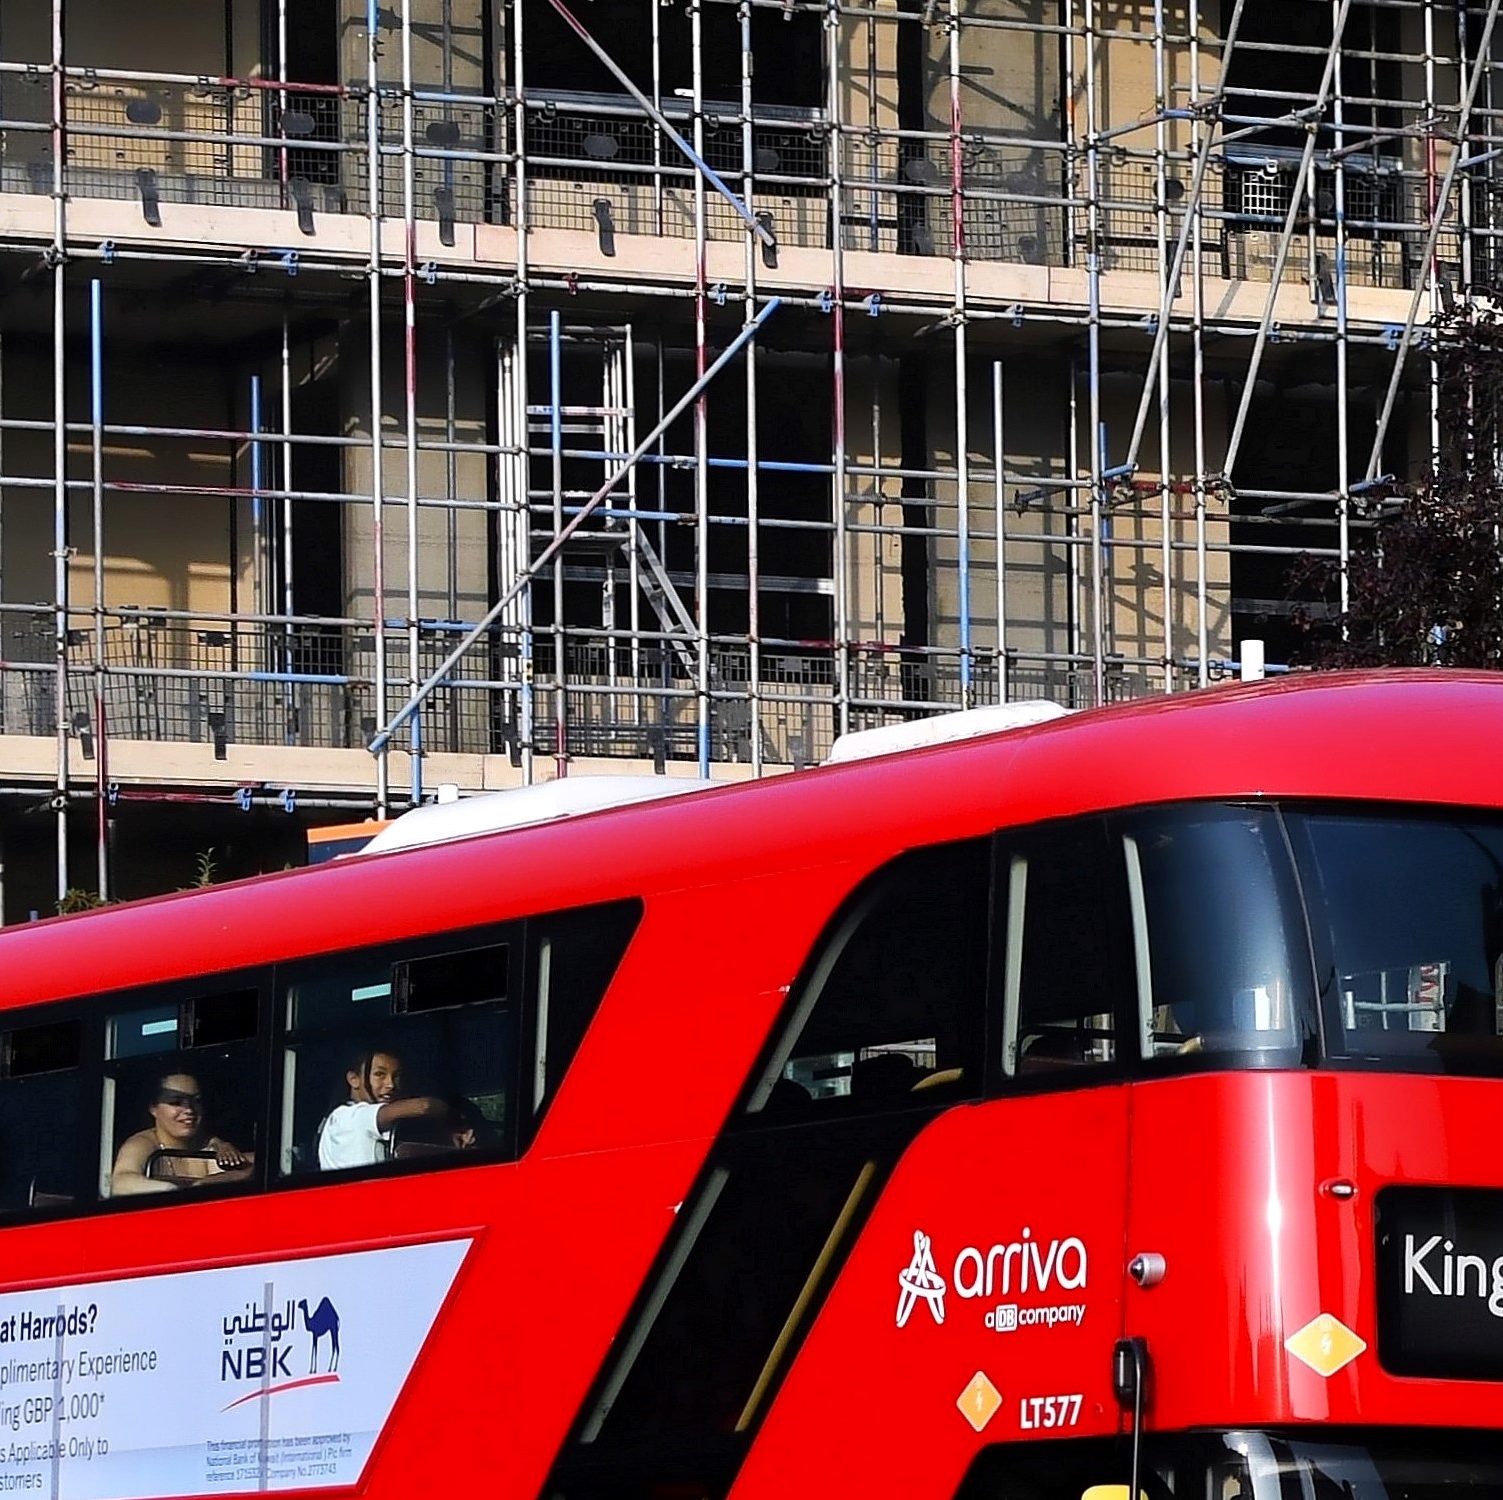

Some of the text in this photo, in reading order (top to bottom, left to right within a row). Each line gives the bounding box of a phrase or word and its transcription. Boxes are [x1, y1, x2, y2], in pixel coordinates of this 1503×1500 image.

[953, 1226, 1087, 1298] arriva
[0, 1315, 16, 1343] at
[20, 1303, 98, 1341] Harrods?
[223, 1299, 296, 1345] الوطني
[985, 1304, 1086, 1328] a DB company
[79, 1347, 157, 1381] Experience
[221, 1345, 293, 1381] NBK
[24, 1397, 53, 1424] GBP
[1020, 1394, 1083, 1429] LT577
[8, 1439, 66, 1466] Applicable
[69, 1436, 94, 1461] Only
[97, 1437, 109, 1455] to
